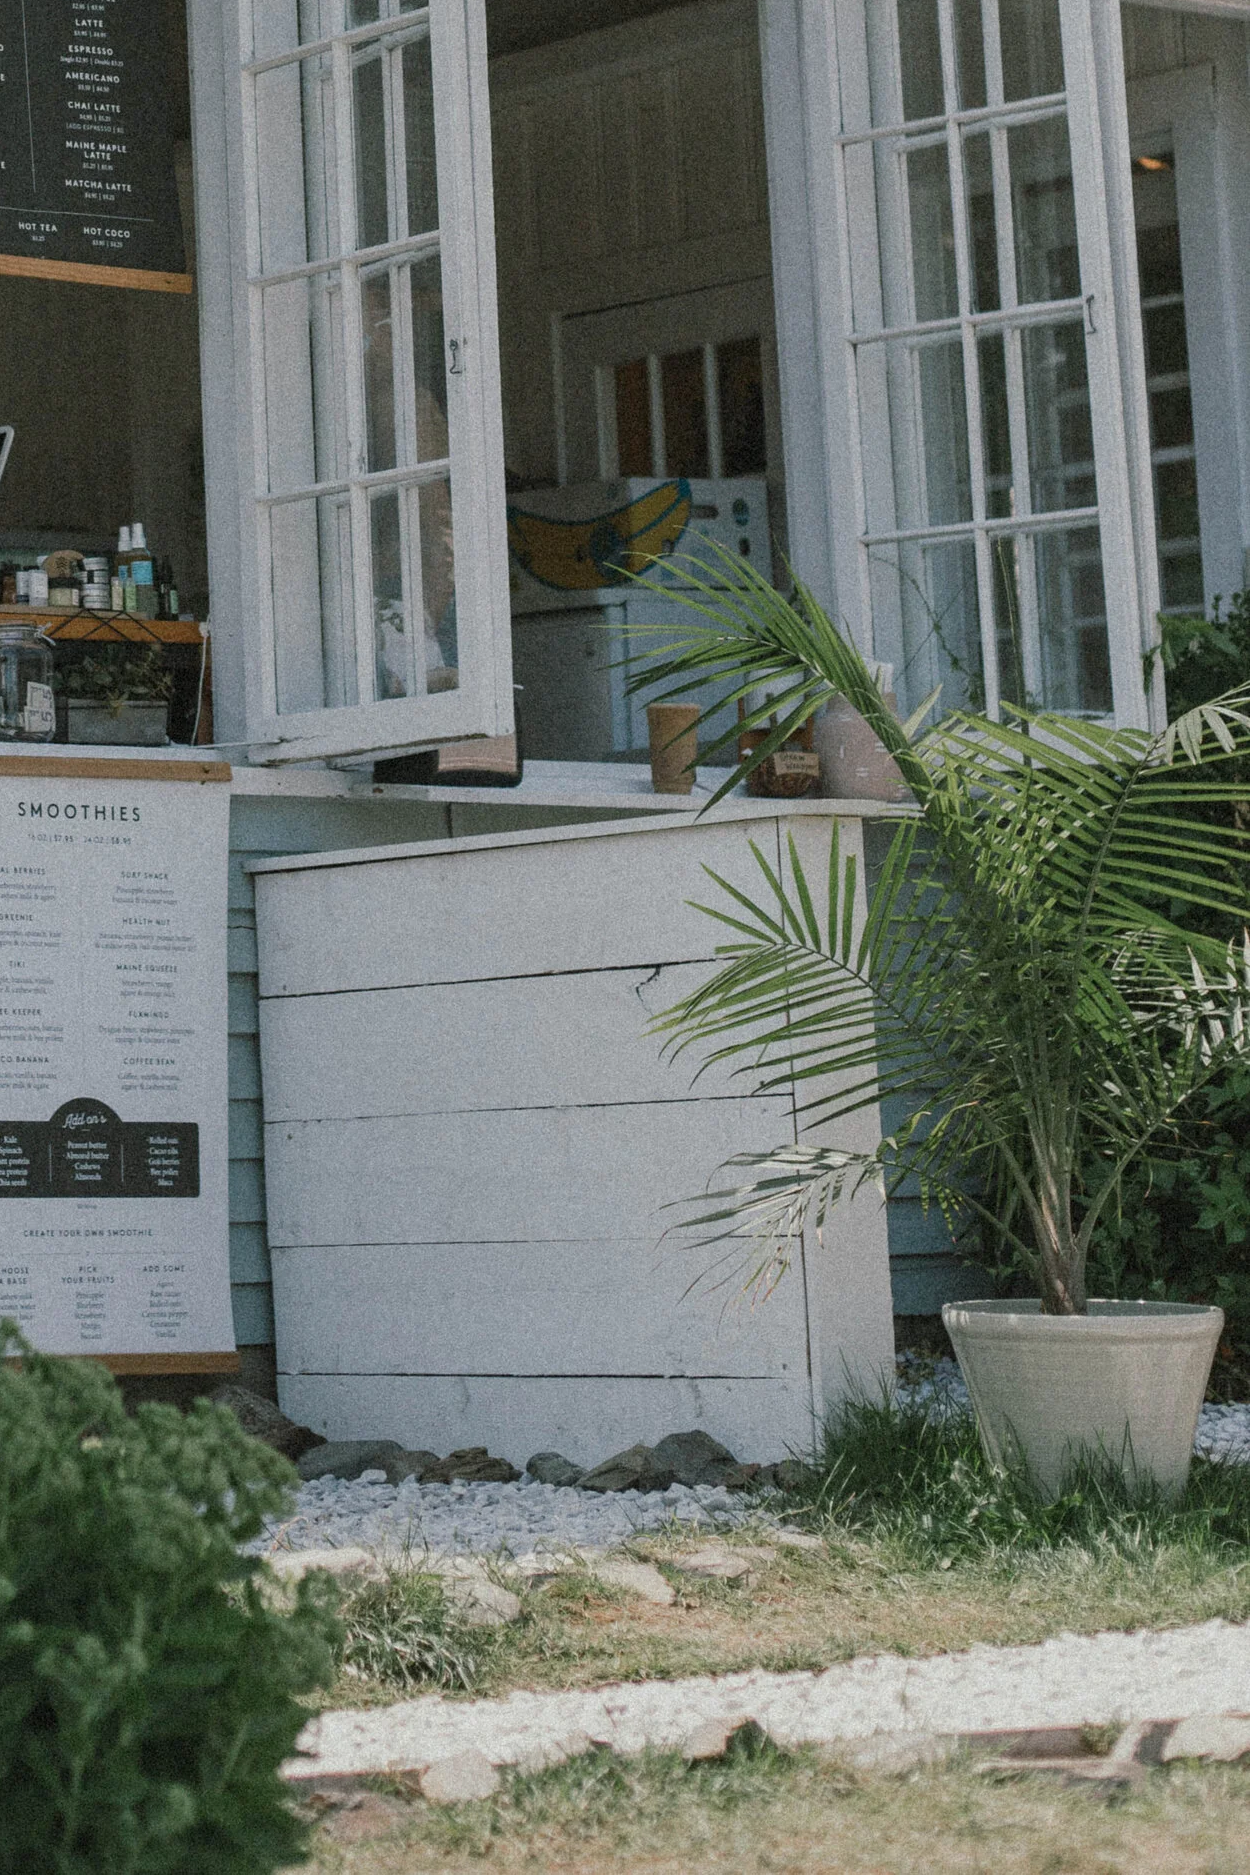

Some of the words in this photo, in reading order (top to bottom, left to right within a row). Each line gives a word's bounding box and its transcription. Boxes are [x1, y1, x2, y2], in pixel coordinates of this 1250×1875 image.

[75, 19, 103, 28] LATTE
[68, 45, 113, 56] ESPRESSO
[65, 72, 120, 84] AMERICANO
[67, 101, 91, 110] CHAI
[94, 103, 121, 113] LATTE
[65, 140, 95, 150] MAINE
[99, 143, 127, 153] MAPLE
[84, 151, 111, 160] LATTE
[65, 179, 103, 189] MATCHA
[106, 183, 132, 192] LATTE
[18, 222, 36, 231] HOT
[40, 223, 58, 233] TEA
[83, 227, 102, 236] HOT
[105, 229, 131, 238] COCO
[17, 802, 142, 822] SMOOTHIES
[13, 867, 46, 876] BERRIES
[121, 871, 141, 879] SURF
[144, 872, 168, 880] SHACK
[9, 960, 25, 968] TIKI
[145, 965, 178, 973] SQUEEZE
[128, 1010, 169, 1019] FLAMINGO
[63, 1113, 85, 1129] Add
[3, 1135, 17, 1144] Kale
[67, 1141, 88, 1150] Peanut
[89, 1141, 107, 1150] butter
[149, 1147, 167, 1156] Cacao
[65, 1152, 90, 1160] Almond
[90, 1152, 110, 1161] butter
[8, 1158, 30, 1167] protein
[74, 1162, 101, 1171] Cashews
[7, 1168, 28, 1177] protein
[74, 1172, 101, 1181] Almonds
[23, 1229, 55, 1237] CREATE
[107, 1229, 153, 1237] SMOOTHIE
[79, 1266, 97, 1274] PICK
[142, 1265, 160, 1273] ADD
[62, 1276, 83, 1284] YOUR
[87, 1276, 115, 1284] FRUITS
